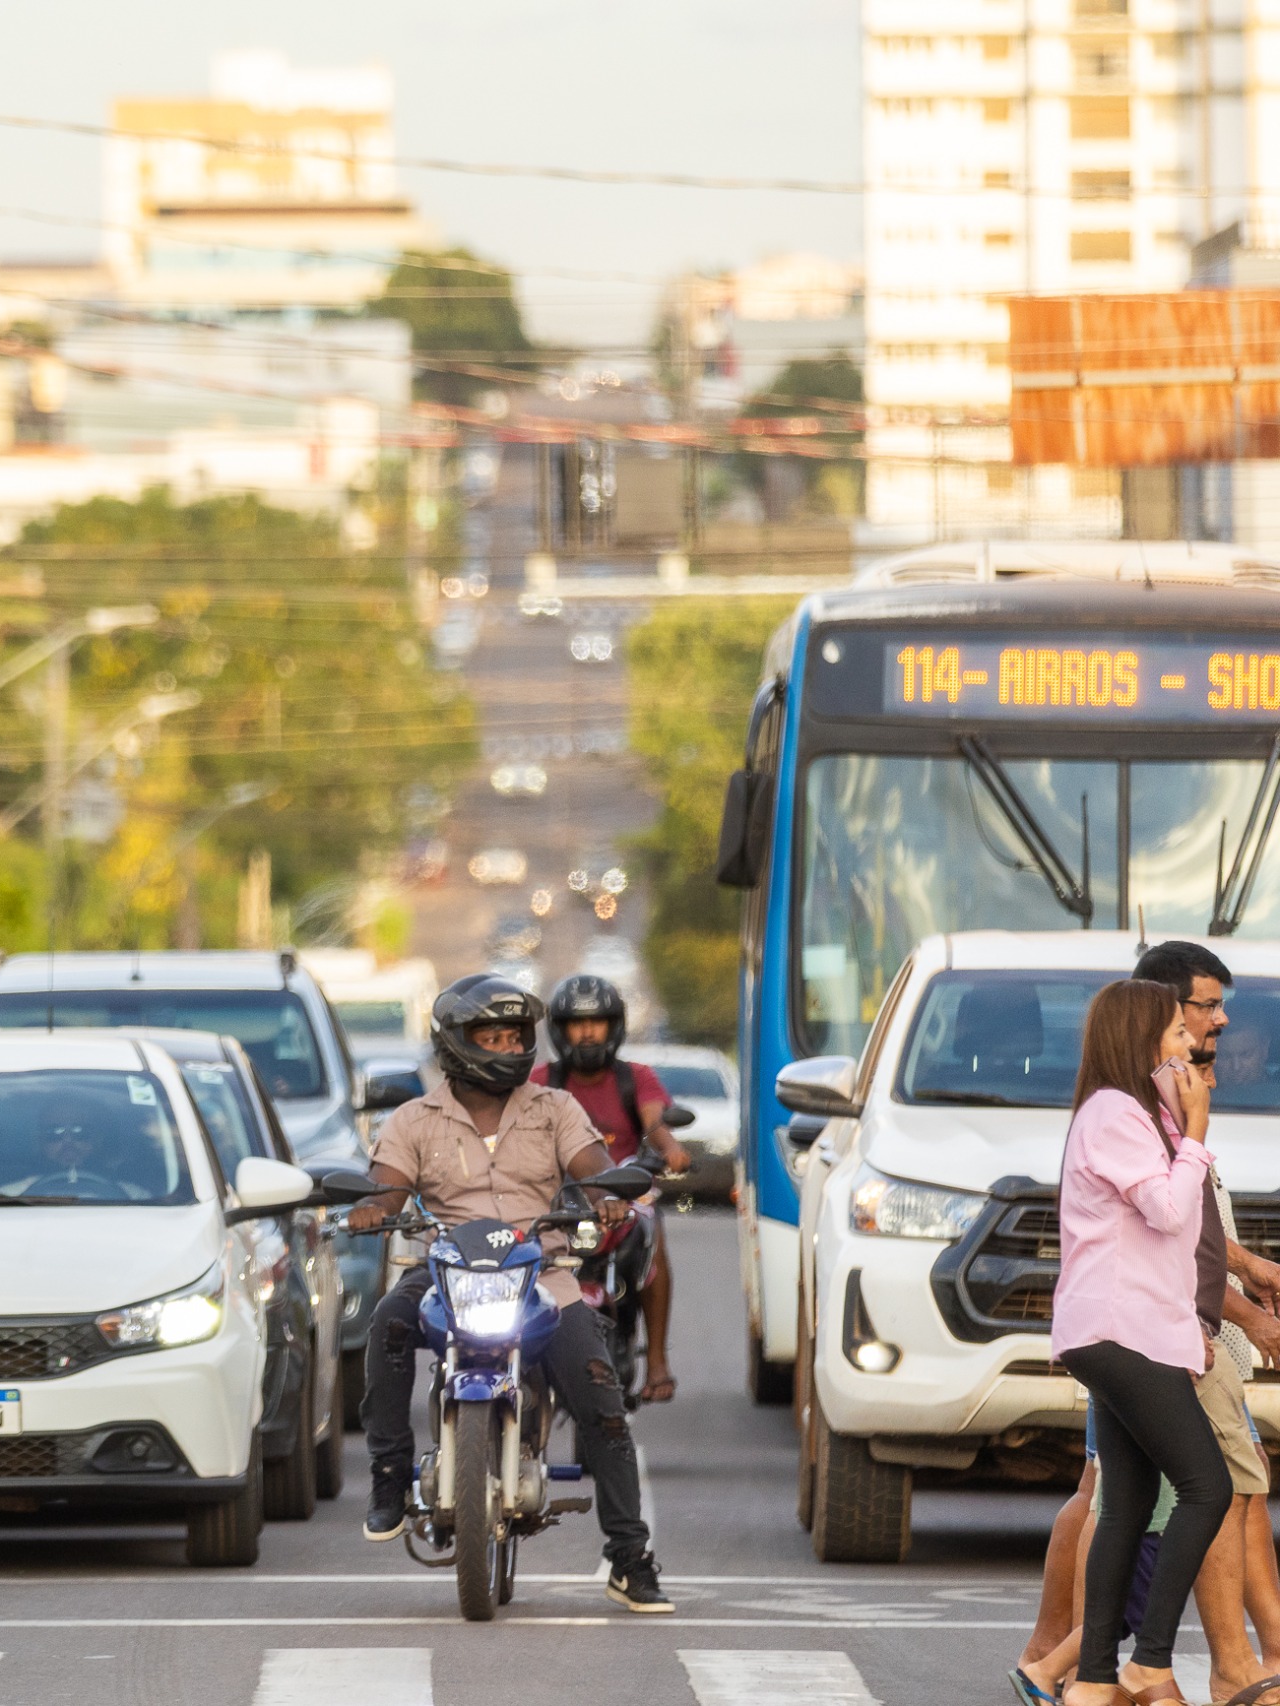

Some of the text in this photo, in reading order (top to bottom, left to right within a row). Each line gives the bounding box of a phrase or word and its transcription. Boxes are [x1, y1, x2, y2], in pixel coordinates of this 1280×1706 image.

[897, 646, 988, 703] 114-
[999, 648, 1138, 707] AIRROS
[1207, 652, 1280, 710] SHO
